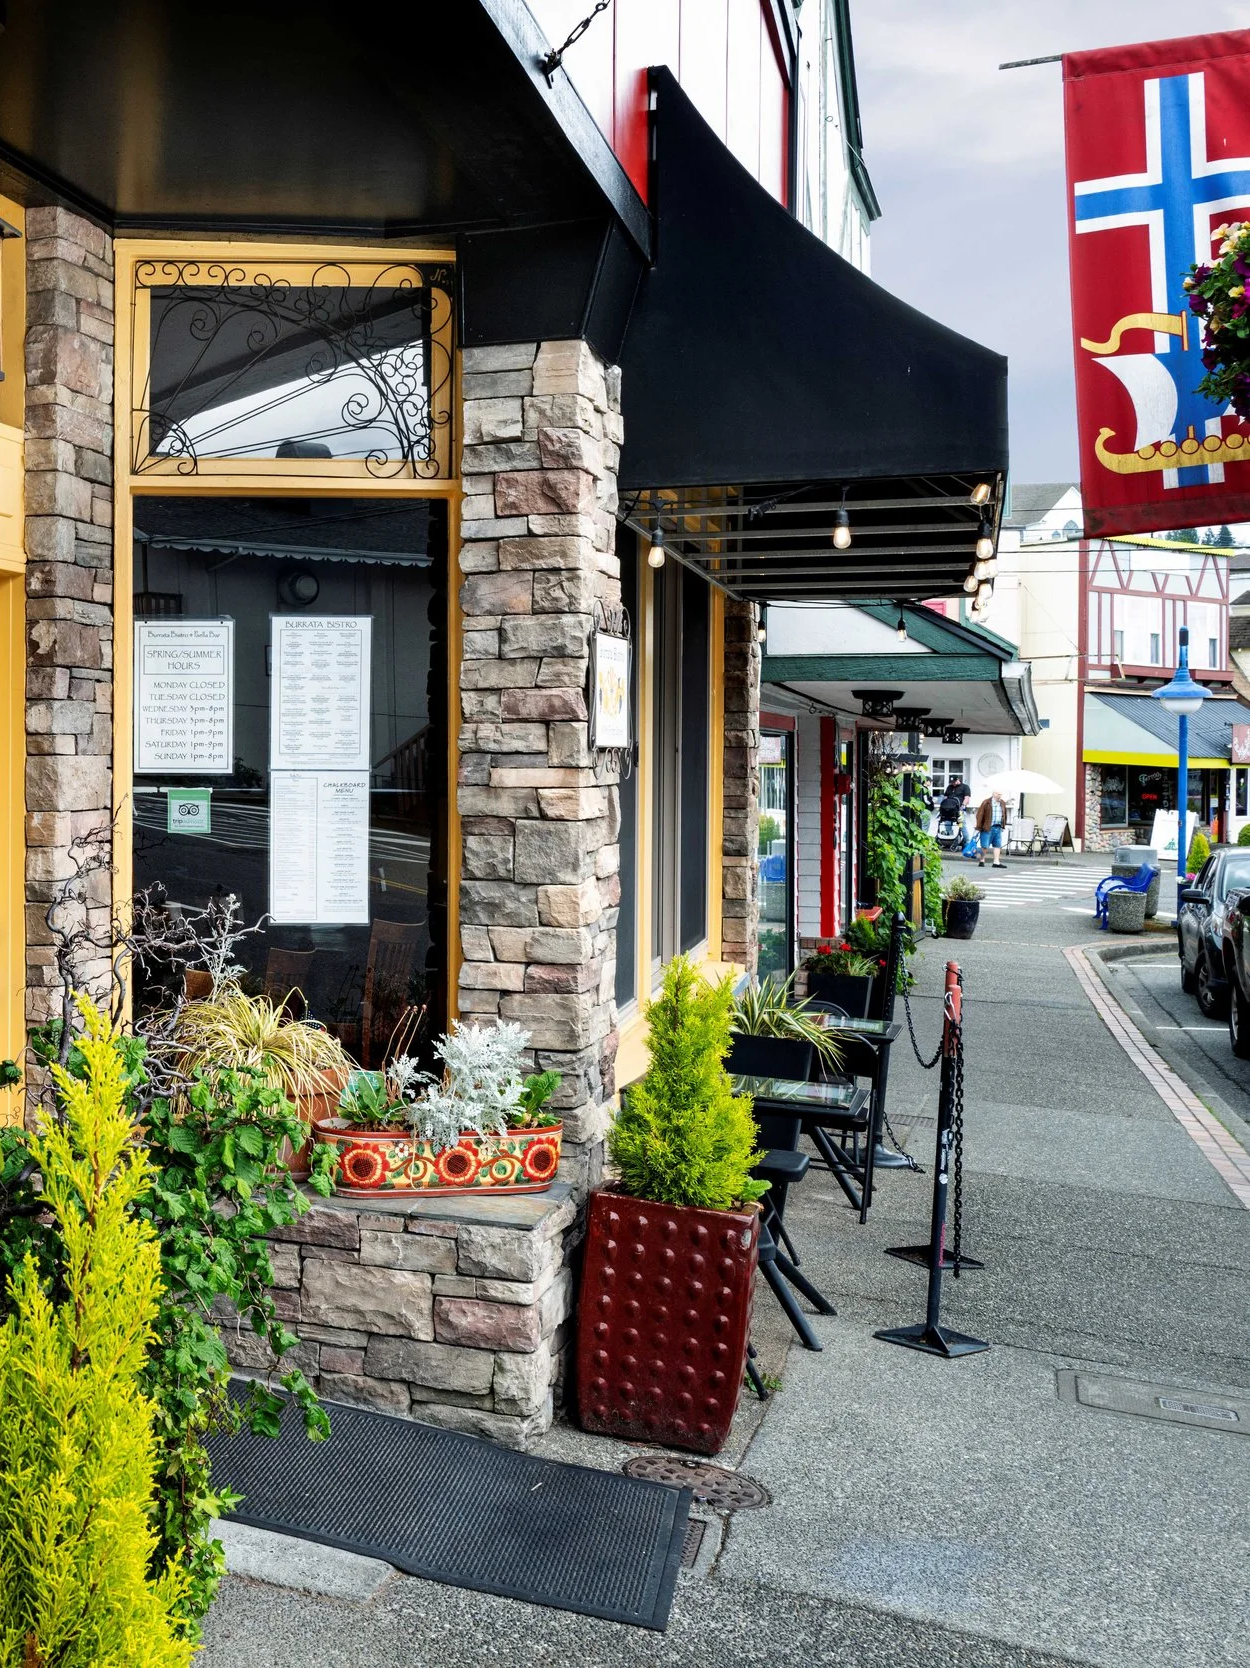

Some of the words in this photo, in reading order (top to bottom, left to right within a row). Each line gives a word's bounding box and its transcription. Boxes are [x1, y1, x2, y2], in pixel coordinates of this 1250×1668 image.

[285, 621, 324, 629] BURRATA
[327, 621, 358, 629] BISTRO
[146, 649, 222, 659] SPRING/SUMMER
[167, 661, 201, 670] HOURS
[153, 681, 187, 689] MONDAY
[189, 681, 226, 689] CLOSED
[149, 693, 187, 701] TUESDAY
[189, 693, 226, 701] CLOSED
[142, 705, 187, 713] WEDNESDAY
[145, 717, 187, 725] THURSDAY
